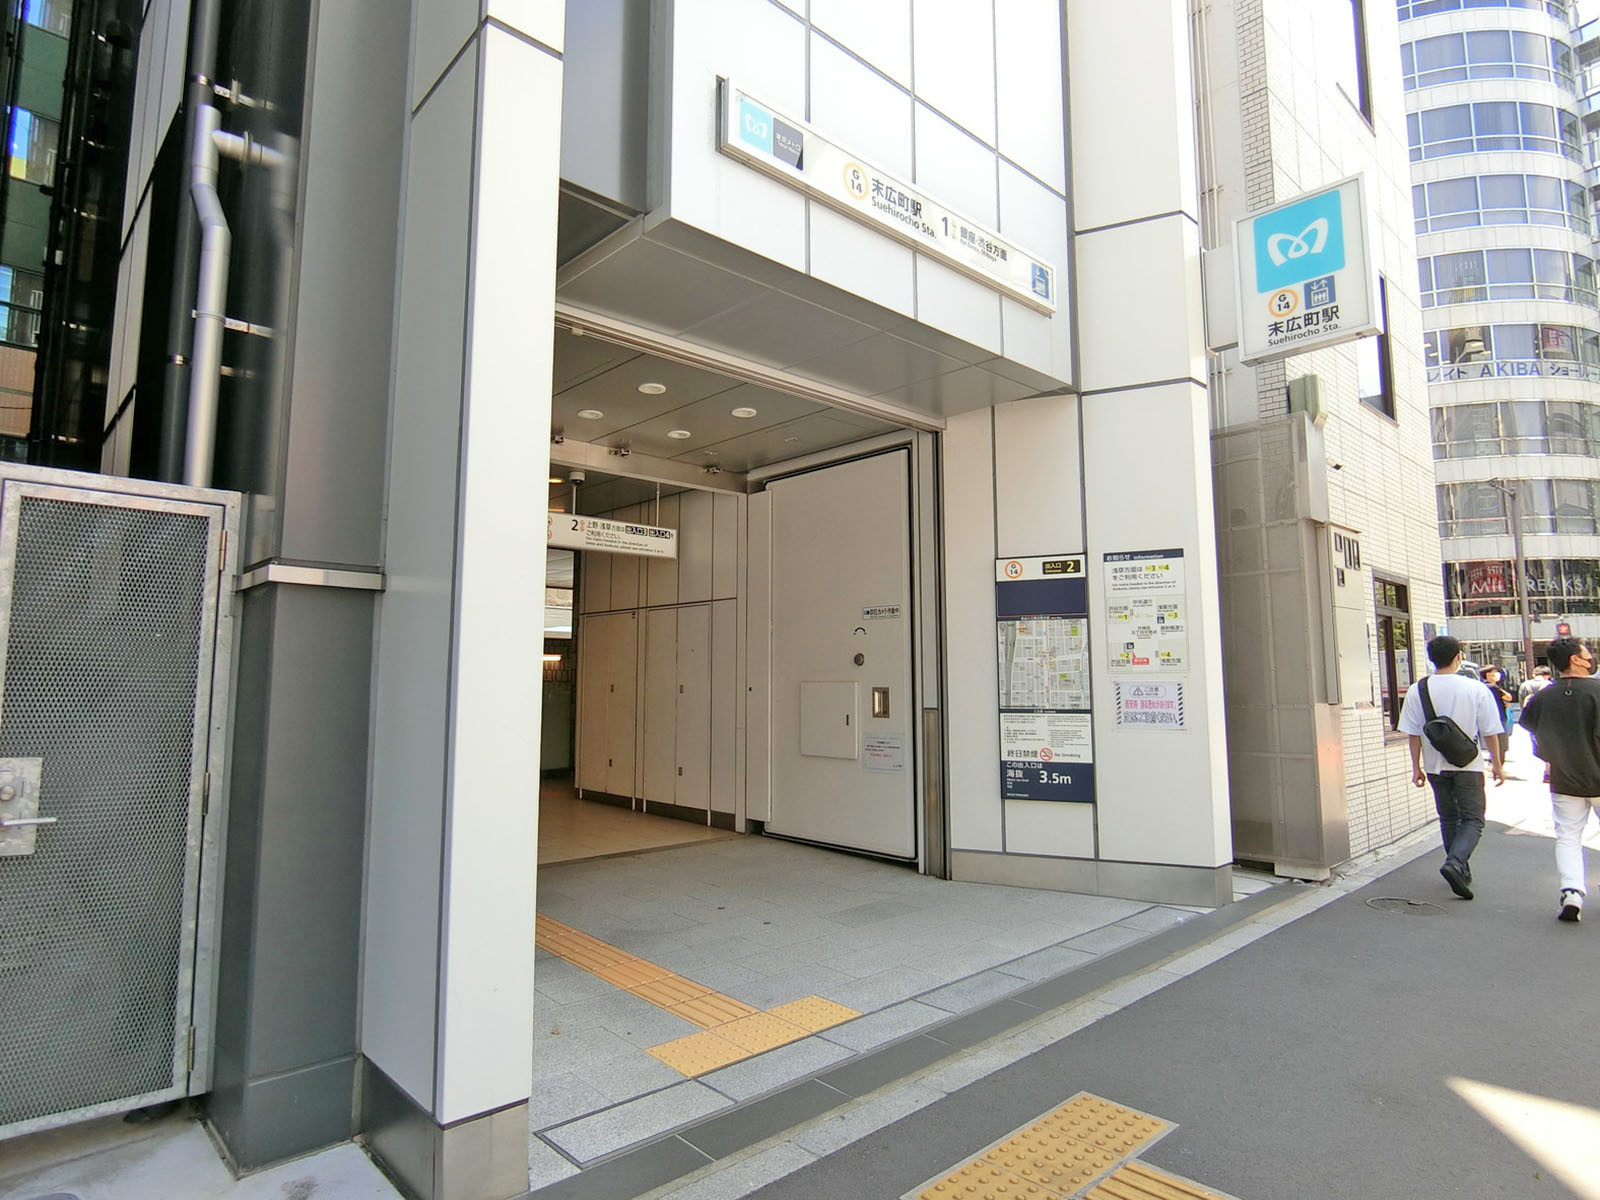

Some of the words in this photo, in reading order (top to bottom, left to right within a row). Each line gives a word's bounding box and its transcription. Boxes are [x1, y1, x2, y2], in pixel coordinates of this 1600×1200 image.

[852, 169, 860, 180] G
[851, 179, 863, 194] 14
[871, 177, 922, 219] 末広町駅
[872, 196, 920, 229] Suehirocho
[921, 223, 937, 239] Sta.
[941, 216, 949, 237] 1
[1278, 293, 1287, 302] G
[1277, 301, 1290, 312] 14
[1268, 305, 1340, 337] 末広町駅
[1268, 327, 1320, 347] Suehirocho
[1323, 322, 1341, 333] Sta.
[1480, 361, 1541, 378] AKIBA
[571, 519, 579, 531] 2
[1066, 561, 1075, 573] 2
[1007, 749, 1038, 758] 終日禁煙
[1006, 761, 1043, 769] この出入口は
[1039, 770, 1072, 784] 3.5m
